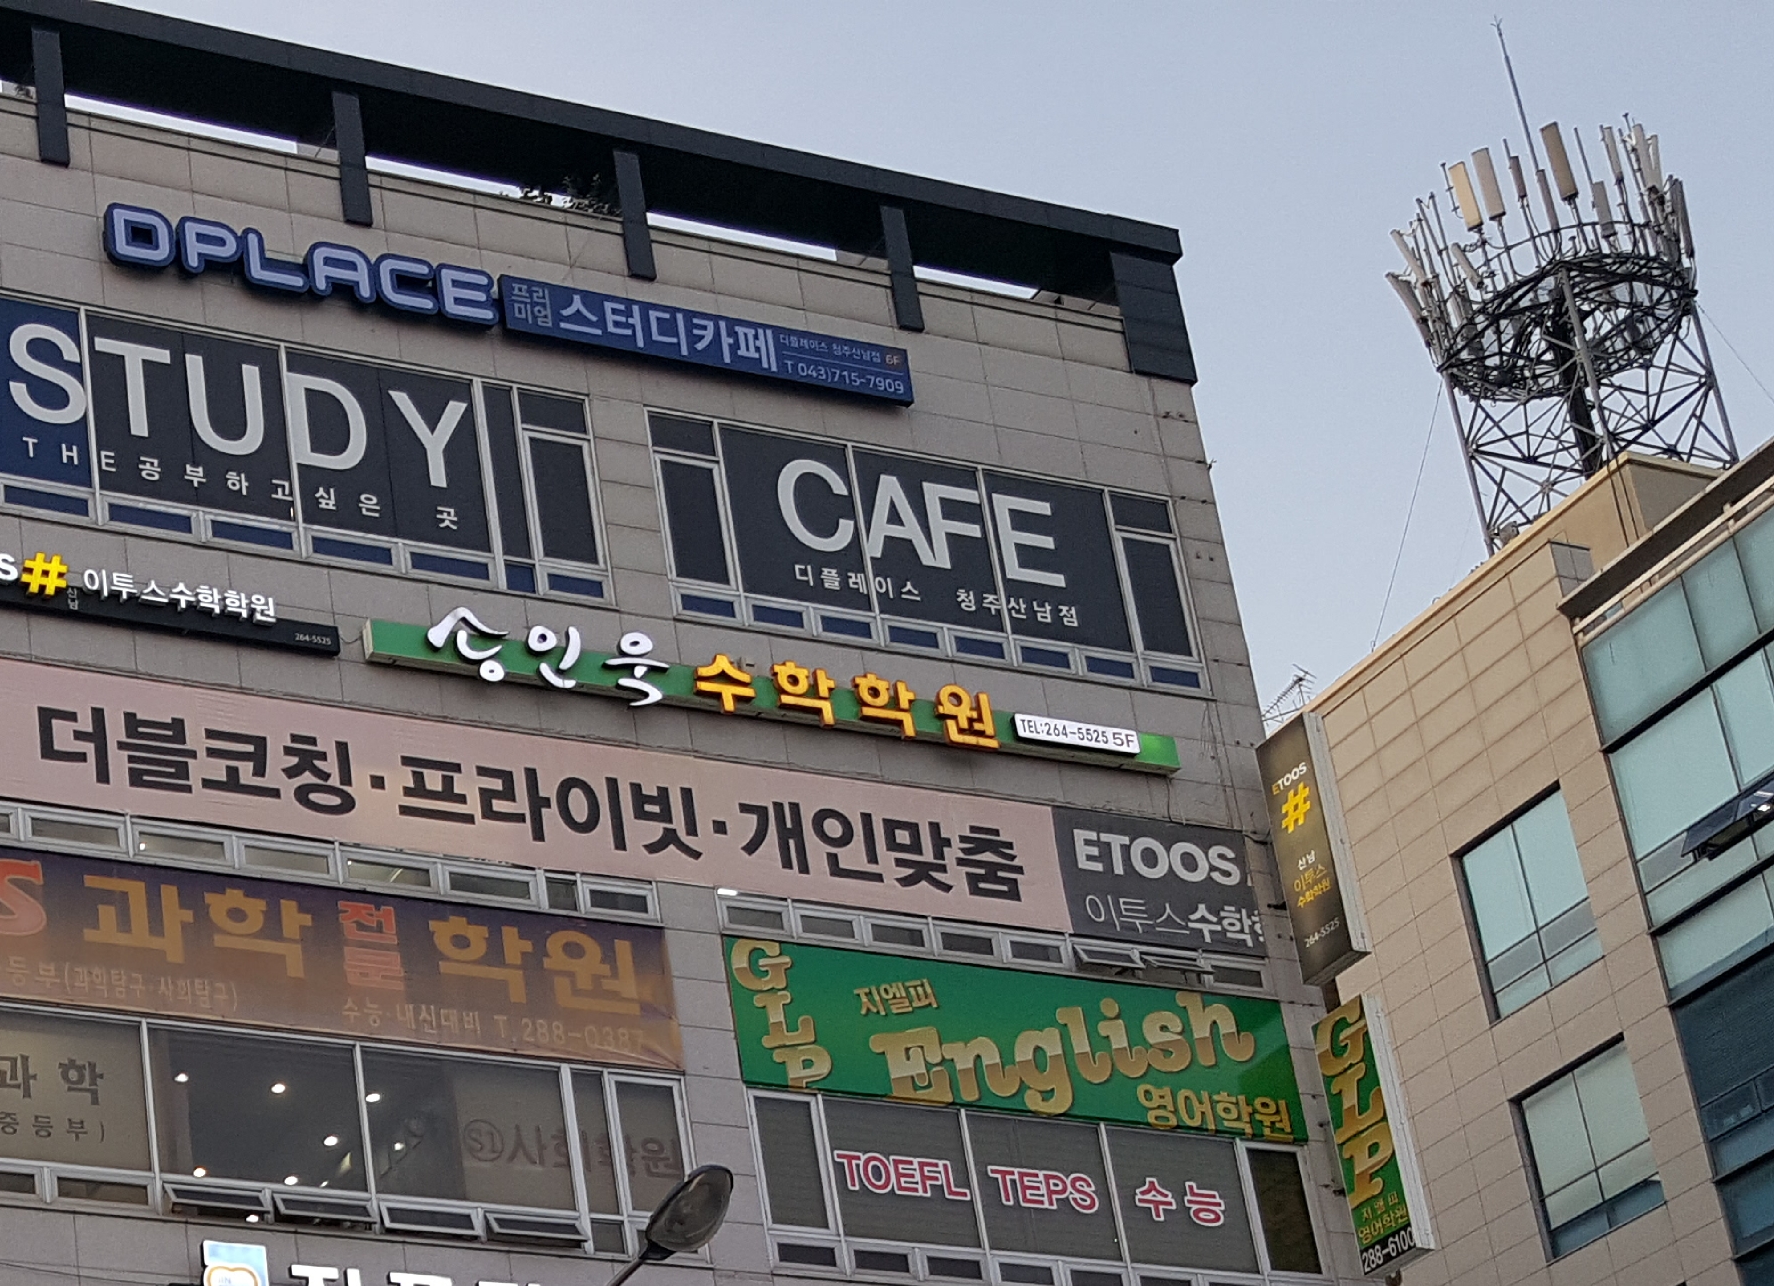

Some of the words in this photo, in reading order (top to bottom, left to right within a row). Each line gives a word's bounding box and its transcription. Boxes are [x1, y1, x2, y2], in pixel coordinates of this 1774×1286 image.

[105, 204, 498, 325] DPLACE
[510, 281, 550, 305] 프리
[557, 293, 779, 373] 스터디카페
[512, 303, 554, 328] 미엄
[8, 321, 469, 490] STUDY
[797, 362, 905, 394] 043)715-7909
[436, 505, 459, 531] 곳
[776, 458, 1067, 589] CAFE
[82, 567, 278, 625] 이투스수학학원
[793, 562, 922, 604] 디플레이스
[956, 586, 1079, 629] 청주산남점
[692, 652, 1001, 752] 수학학원
[1018, 717, 1110, 749] TEL:264-5525
[1111, 728, 1137, 751] 5F
[1271, 761, 1308, 796] ETOOS
[1072, 828, 1242, 887] ETOOS
[1293, 863, 1327, 893] 이투스
[81, 872, 315, 980] 과학
[337, 900, 407, 992] 전문
[428, 914, 642, 1016] 학원
[729, 938, 834, 1091] GLP
[853, 976, 940, 1018] 지엘피
[869, 991, 1257, 1117] English
[1136, 1082, 1293, 1144] 영어학원
[833, 1150, 972, 1202] TOEFL
[987, 1165, 1100, 1216] TEPS
[1134, 1175, 1225, 1228] 수능
[1357, 1205, 1410, 1245] 영어학원
[1361, 1226, 1417, 1274] 288-6100
